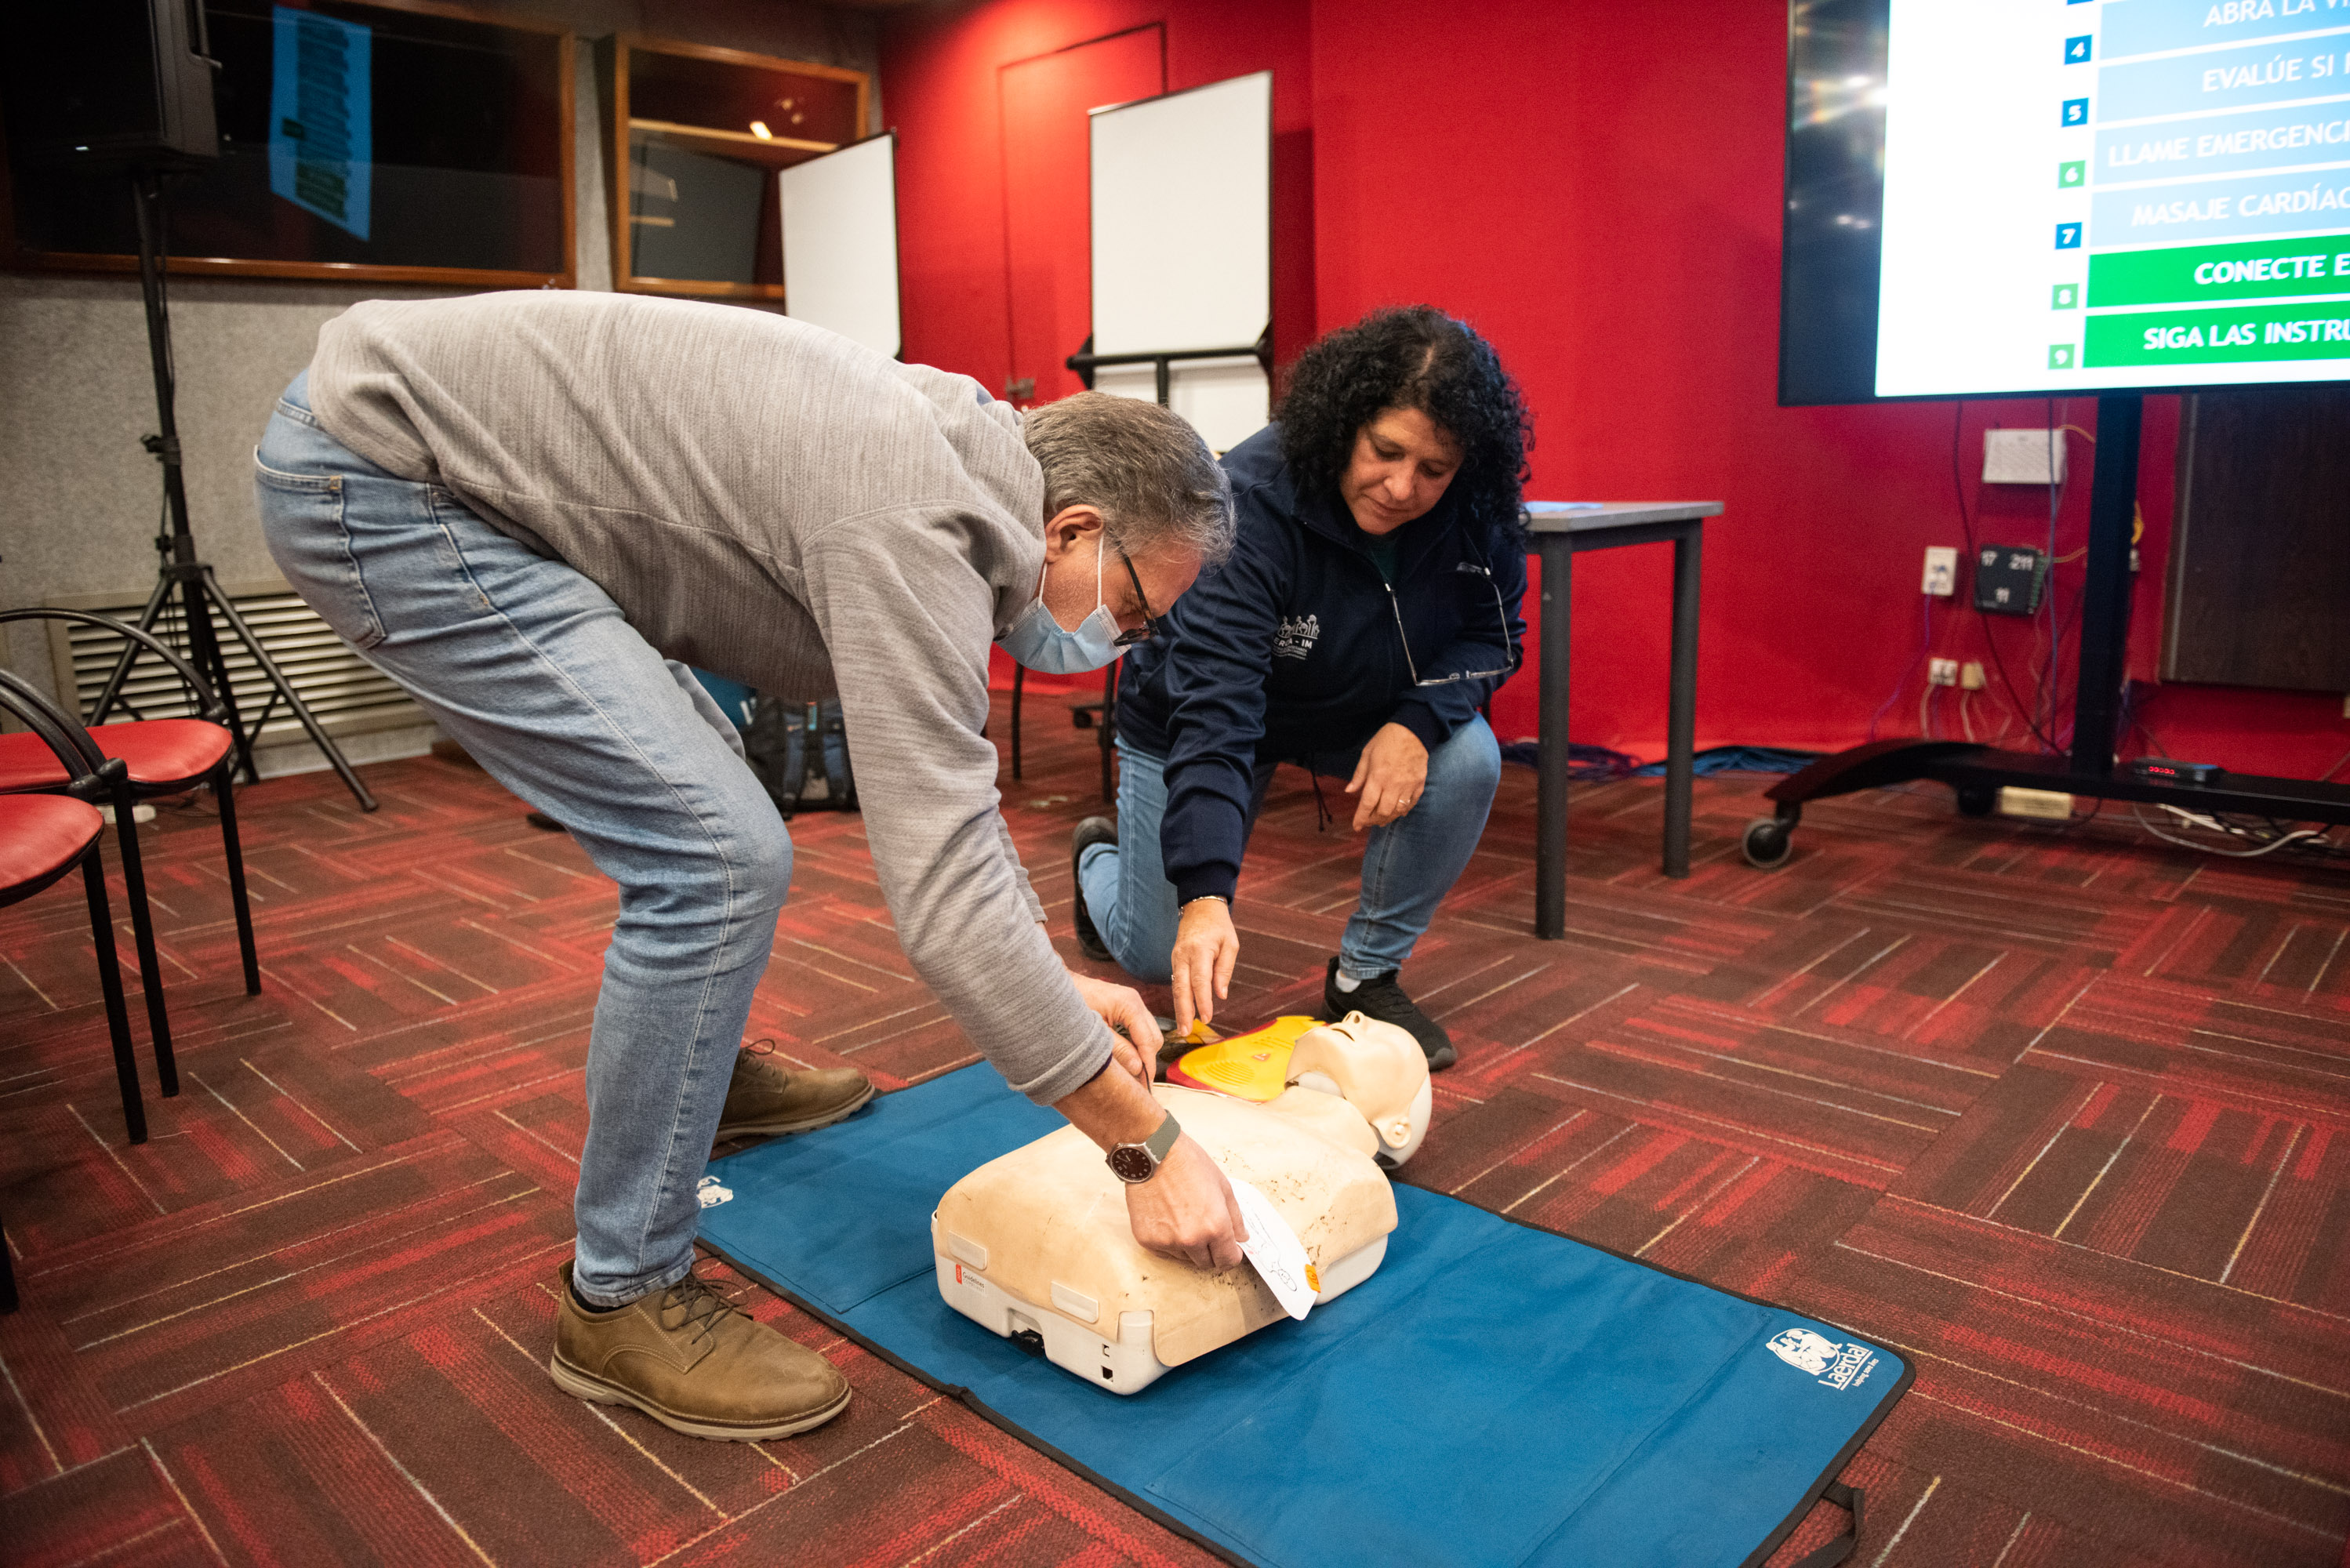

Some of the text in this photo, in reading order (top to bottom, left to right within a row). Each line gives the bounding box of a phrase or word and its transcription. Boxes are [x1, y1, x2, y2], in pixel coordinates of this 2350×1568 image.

[2070, 42, 2086, 57] 4
[2203, 0, 2275, 27] ABRA
[2282, 0, 2315, 16] LA
[2068, 104, 2082, 122] 5
[2203, 53, 2304, 93] EVALÚE
[2310, 54, 2334, 78] SI
[2065, 120, 2350, 183] 6 LLAME EMERGENCI
[2061, 227, 2076, 245] 7
[2130, 196, 2232, 227] MASAJE
[2058, 289, 2072, 305] 8
[2194, 254, 2327, 285] CONECTE
[2054, 350, 2068, 365] 9
[2143, 326, 2204, 350] SIGA
[2209, 323, 2257, 347] LAS
[1818, 1343, 1869, 1389] Laerdal
